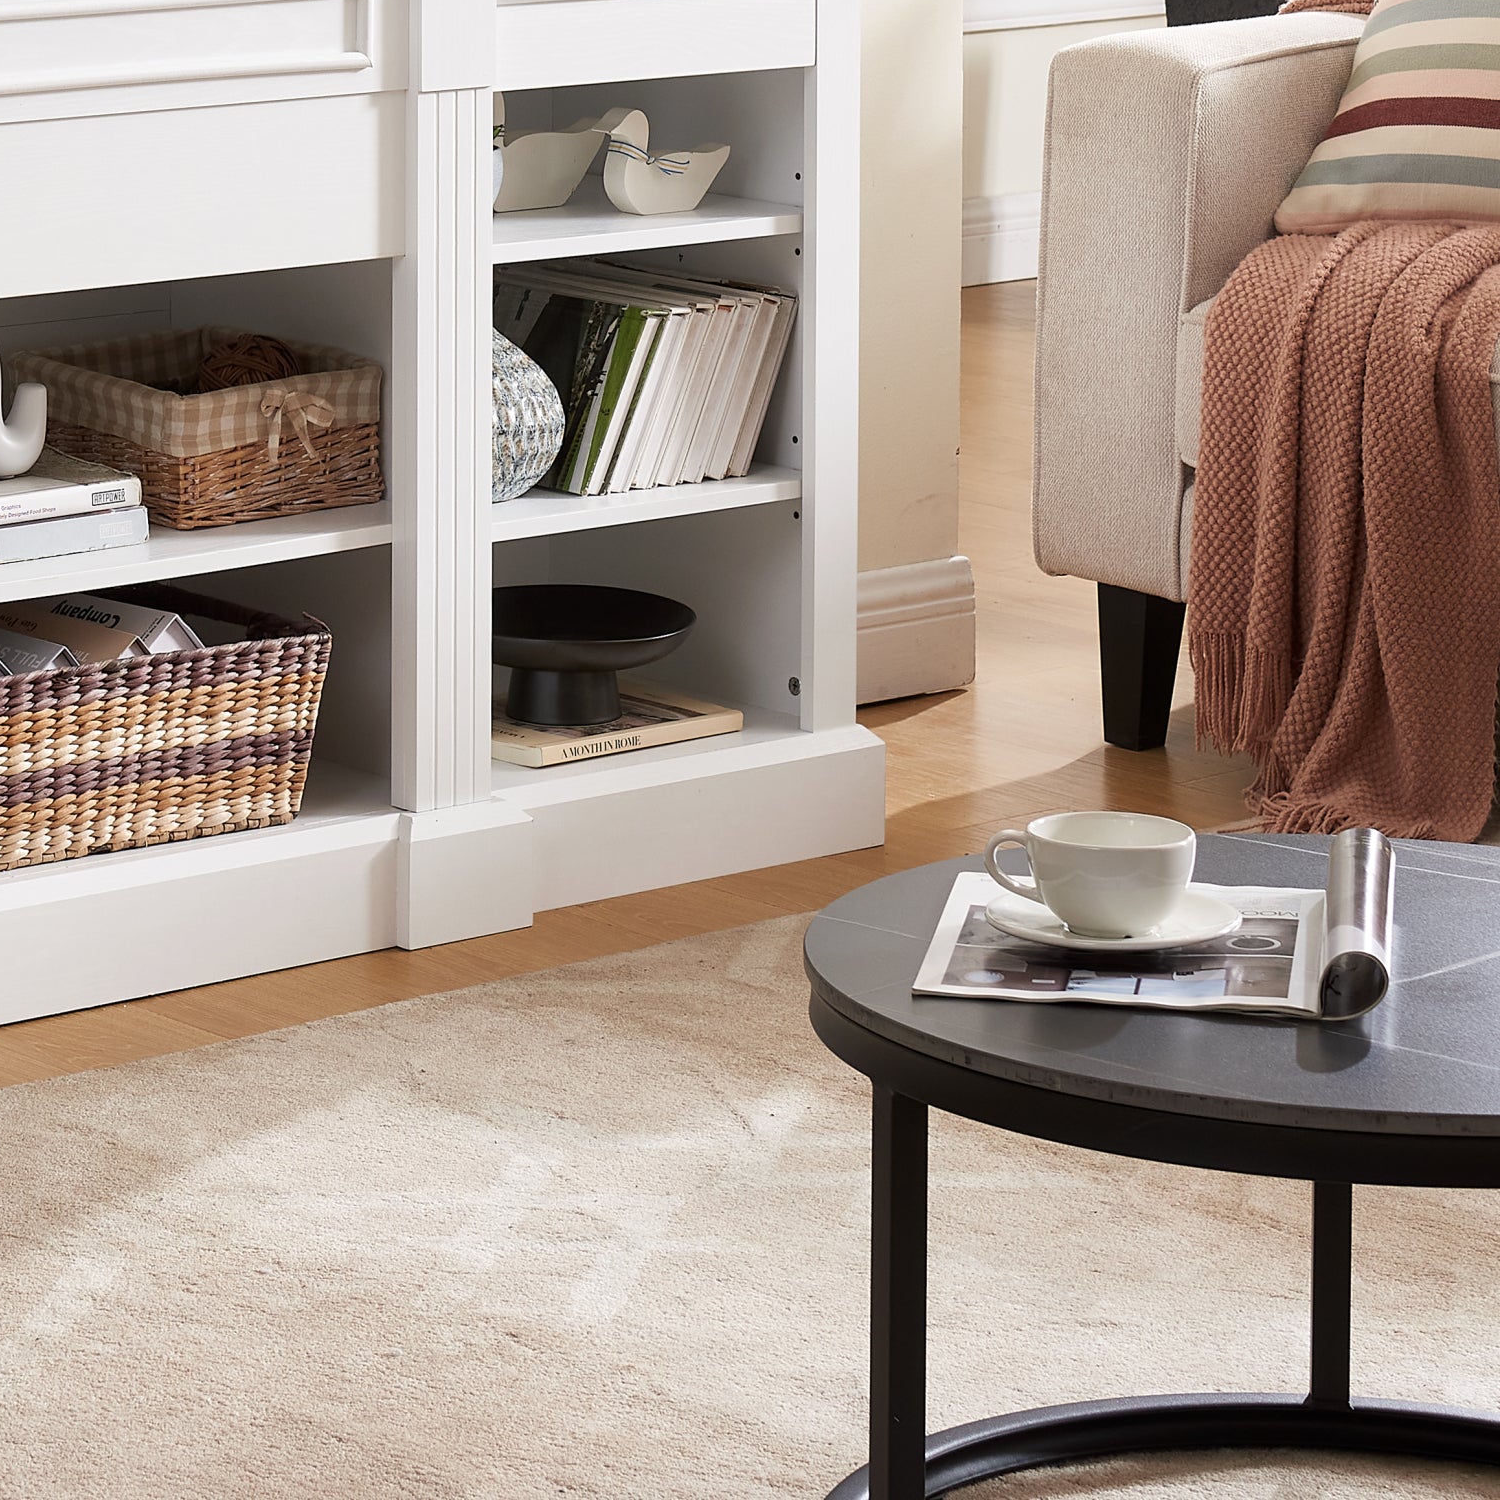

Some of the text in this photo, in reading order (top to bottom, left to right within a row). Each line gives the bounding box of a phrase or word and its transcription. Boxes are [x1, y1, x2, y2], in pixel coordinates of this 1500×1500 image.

[93, 491, 126, 504] ARTPOWER
[8, 511, 29, 519] Designed
[51, 600, 120, 627] Company
[13, 649, 46, 669] FULL
[561, 735, 642, 759] A MONTH IN ROME
